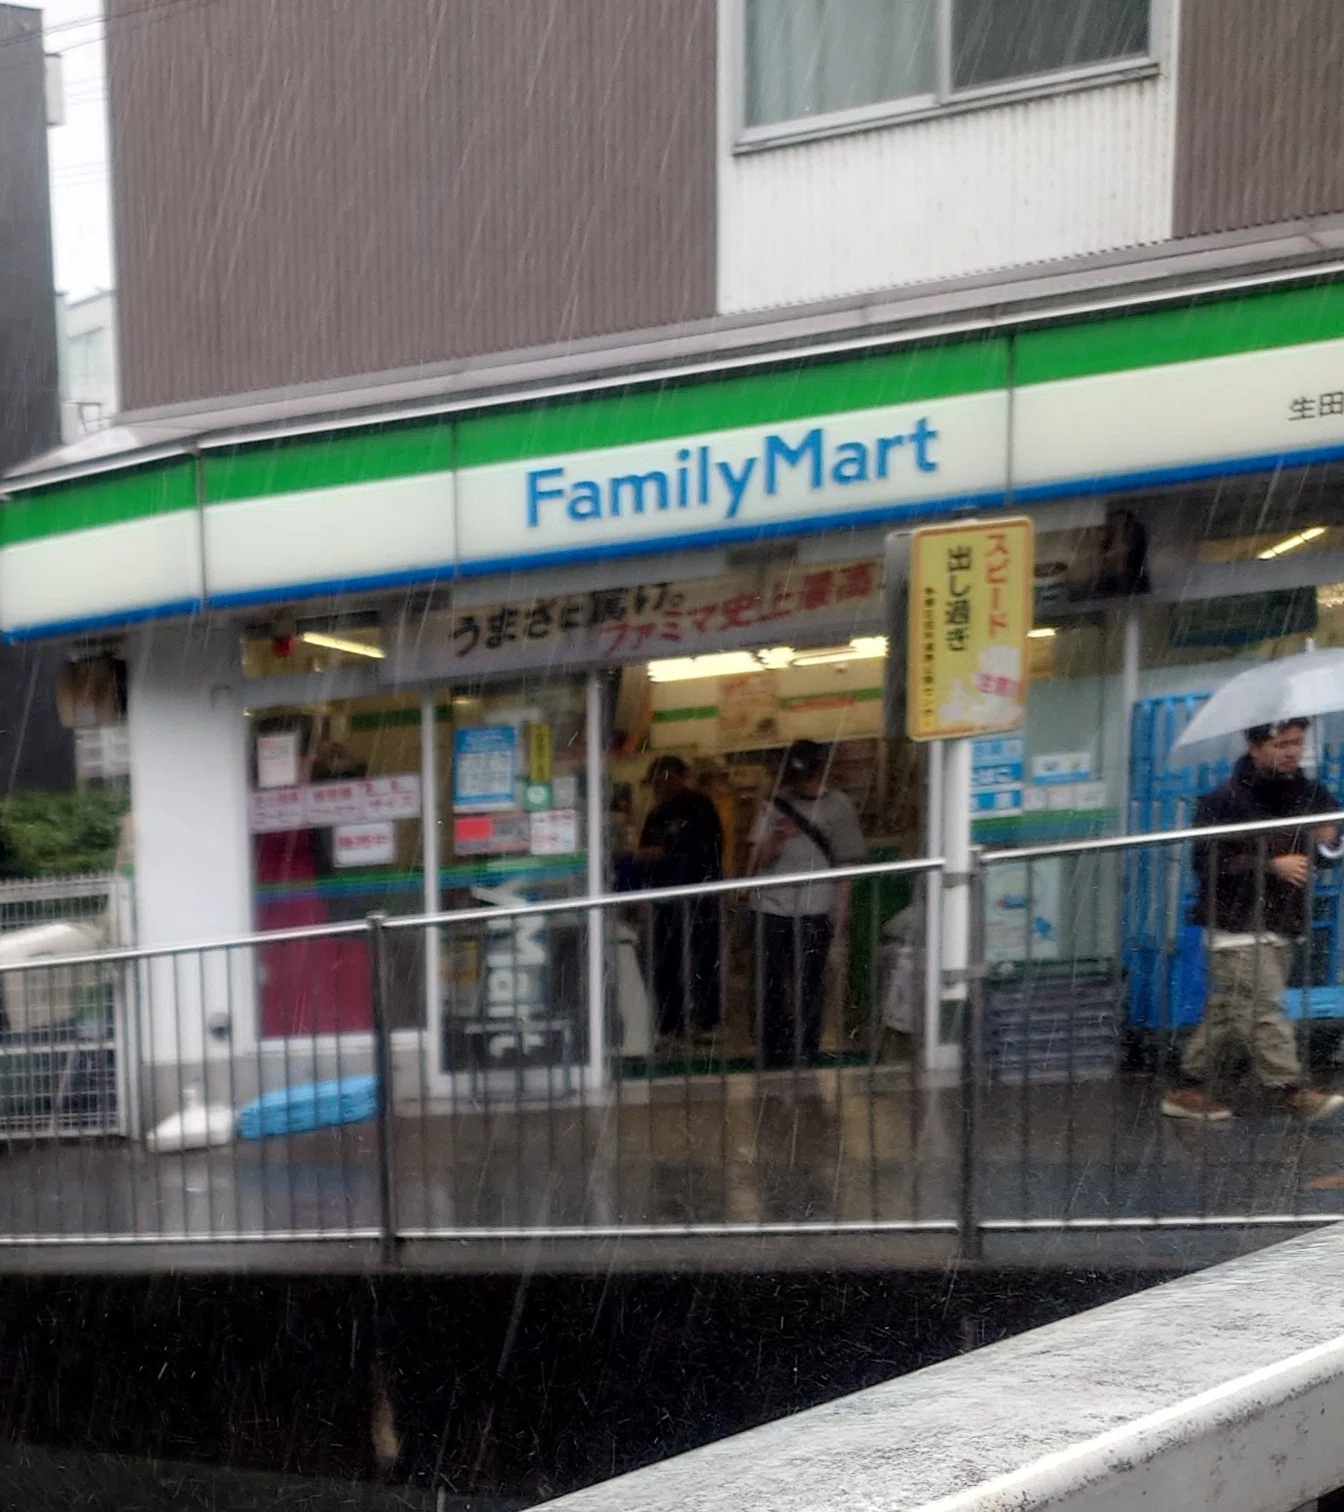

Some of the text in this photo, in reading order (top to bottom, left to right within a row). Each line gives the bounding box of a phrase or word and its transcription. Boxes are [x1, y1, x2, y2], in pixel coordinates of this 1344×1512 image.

[1288, 392, 1344, 421] 生田
[525, 417, 939, 528] FamilyMart
[944, 545, 972, 652] 出し過ぎ
[985, 532, 1010, 640] スピード
